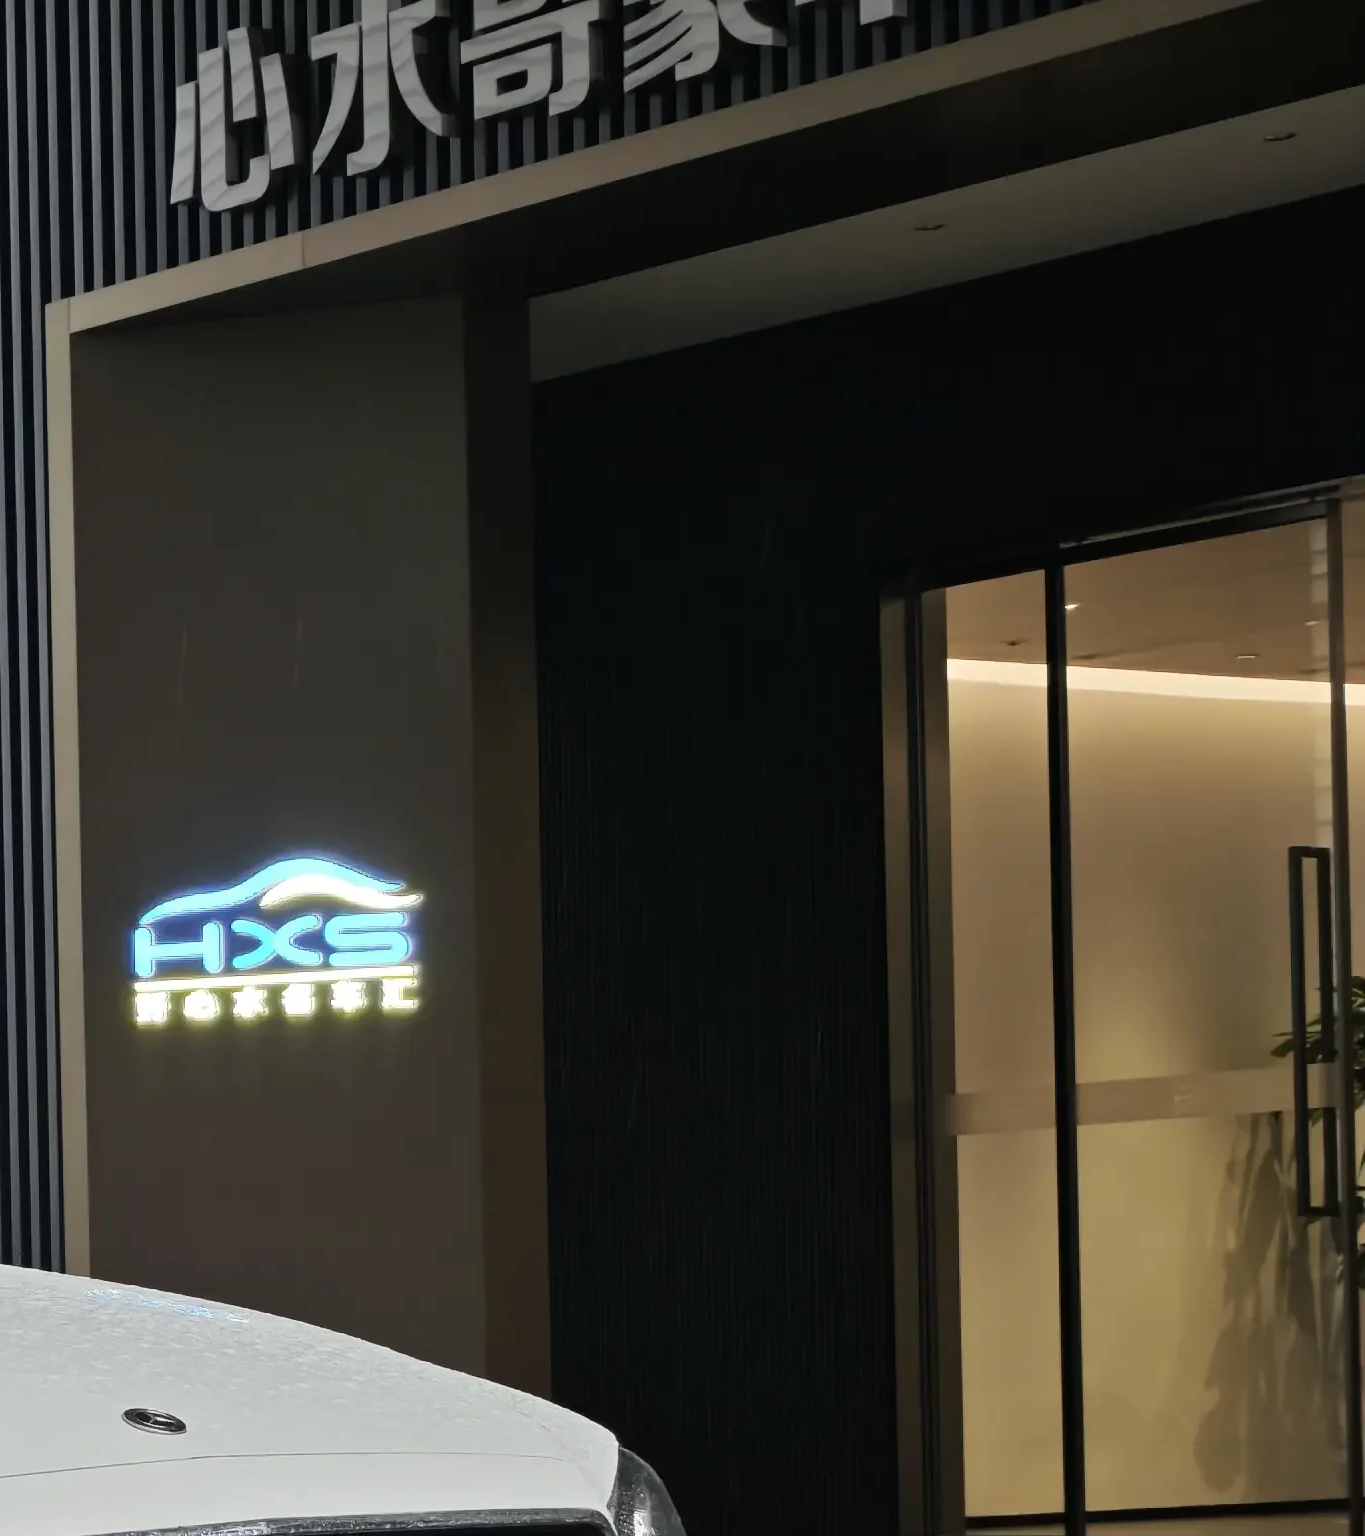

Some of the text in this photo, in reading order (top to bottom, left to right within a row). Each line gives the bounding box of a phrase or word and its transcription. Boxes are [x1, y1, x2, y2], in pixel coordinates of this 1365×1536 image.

[169, 0, 906, 212] 心水哥
[133, 911, 412, 978] HXS
